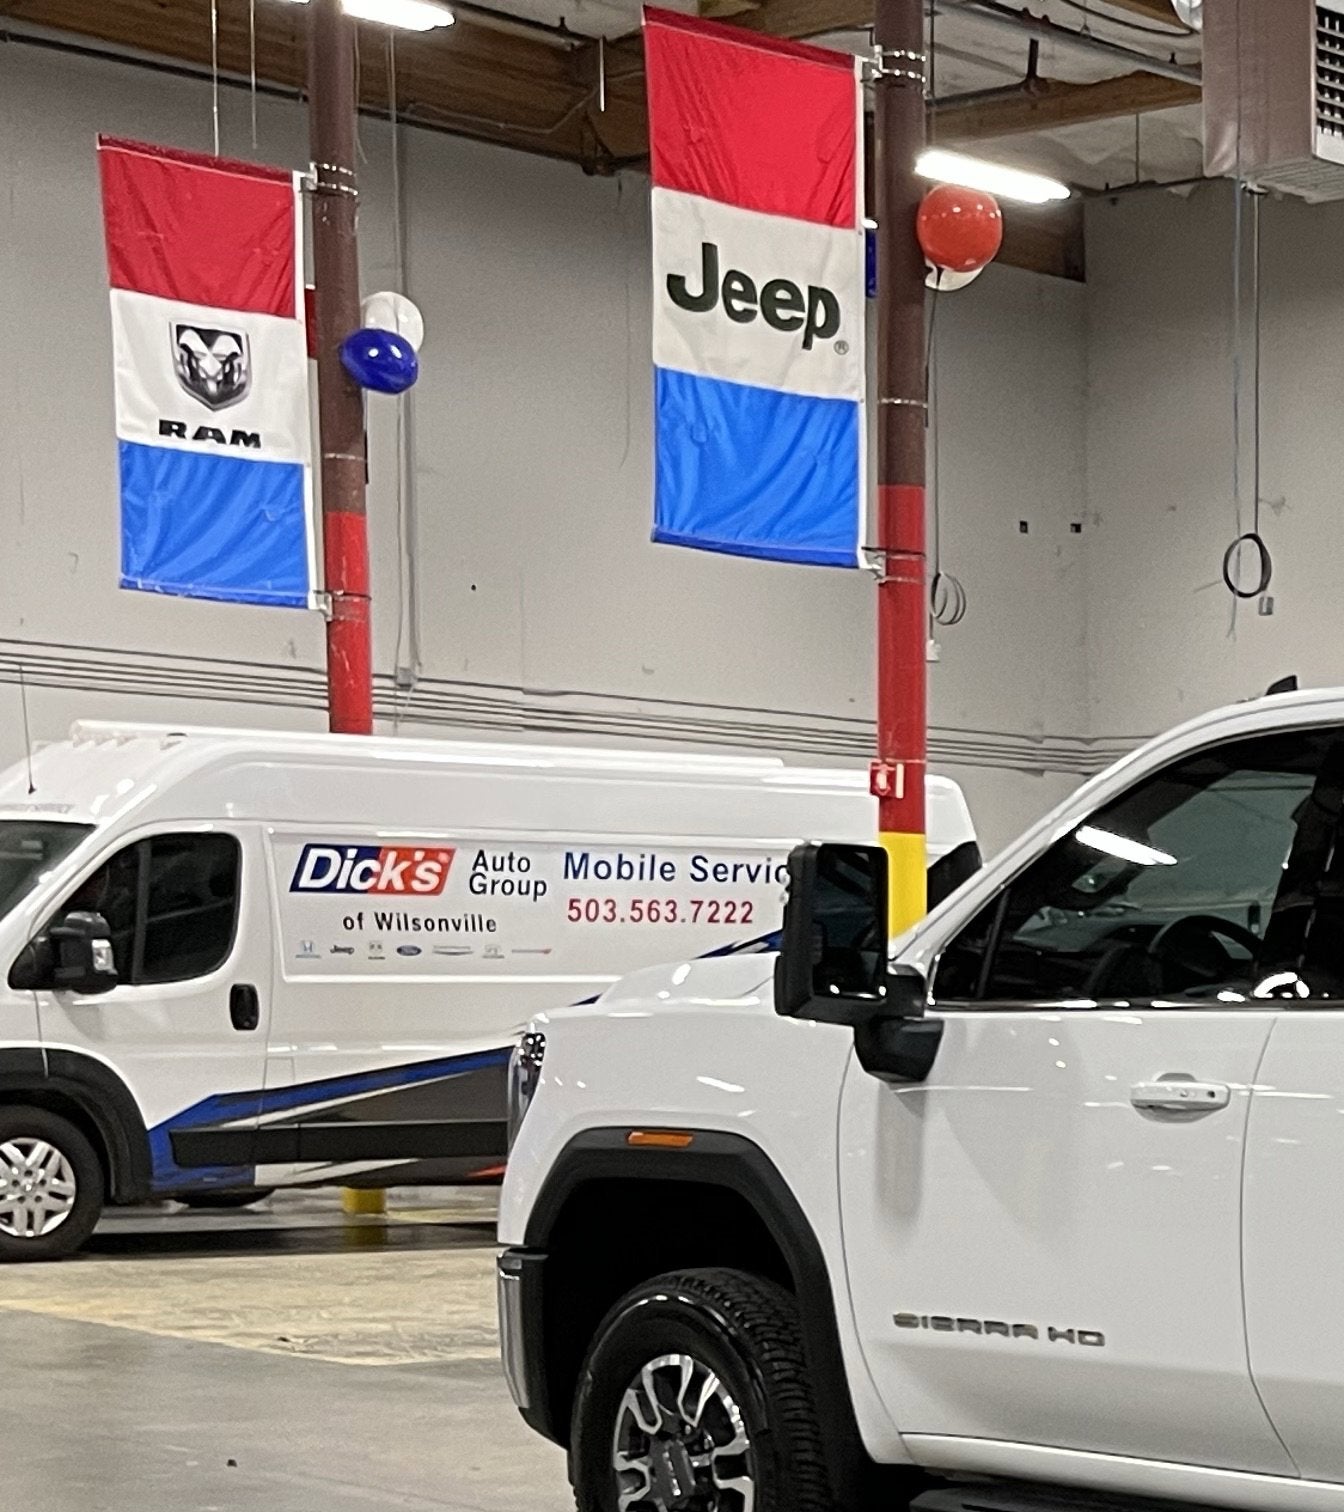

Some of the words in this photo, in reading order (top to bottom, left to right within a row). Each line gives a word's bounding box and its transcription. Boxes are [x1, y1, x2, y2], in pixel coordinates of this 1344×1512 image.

[666, 242, 840, 351] Jeep
[158, 419, 261, 448] RAM
[298, 847, 443, 892] Dick's
[472, 849, 532, 874] Auto
[563, 851, 677, 882] Mobile
[689, 854, 788, 885] Servic
[469, 871, 548, 899] Group
[342, 912, 364, 931] of
[374, 912, 497, 933] Wilsonville
[567, 898, 754, 925] 503.563.7222
[892, 1312, 1040, 1341] SIERRA
[1047, 1325, 1106, 1347] HD
